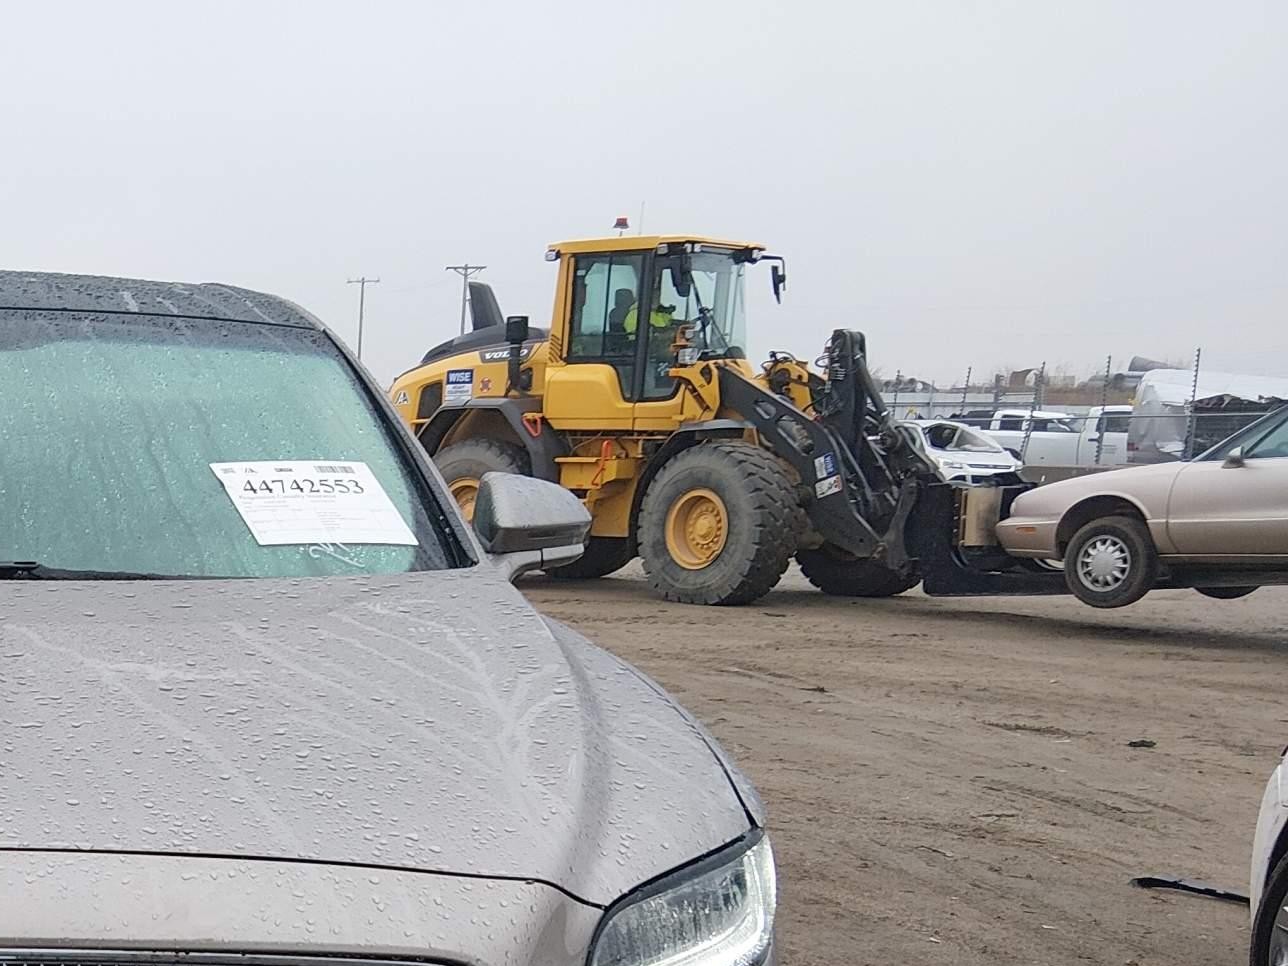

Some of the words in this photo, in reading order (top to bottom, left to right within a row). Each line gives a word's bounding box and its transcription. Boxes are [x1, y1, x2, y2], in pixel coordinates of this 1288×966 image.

[484, 348, 529, 360] VOLO
[448, 371, 472, 382] WISE
[243, 478, 365, 495] 44742553
